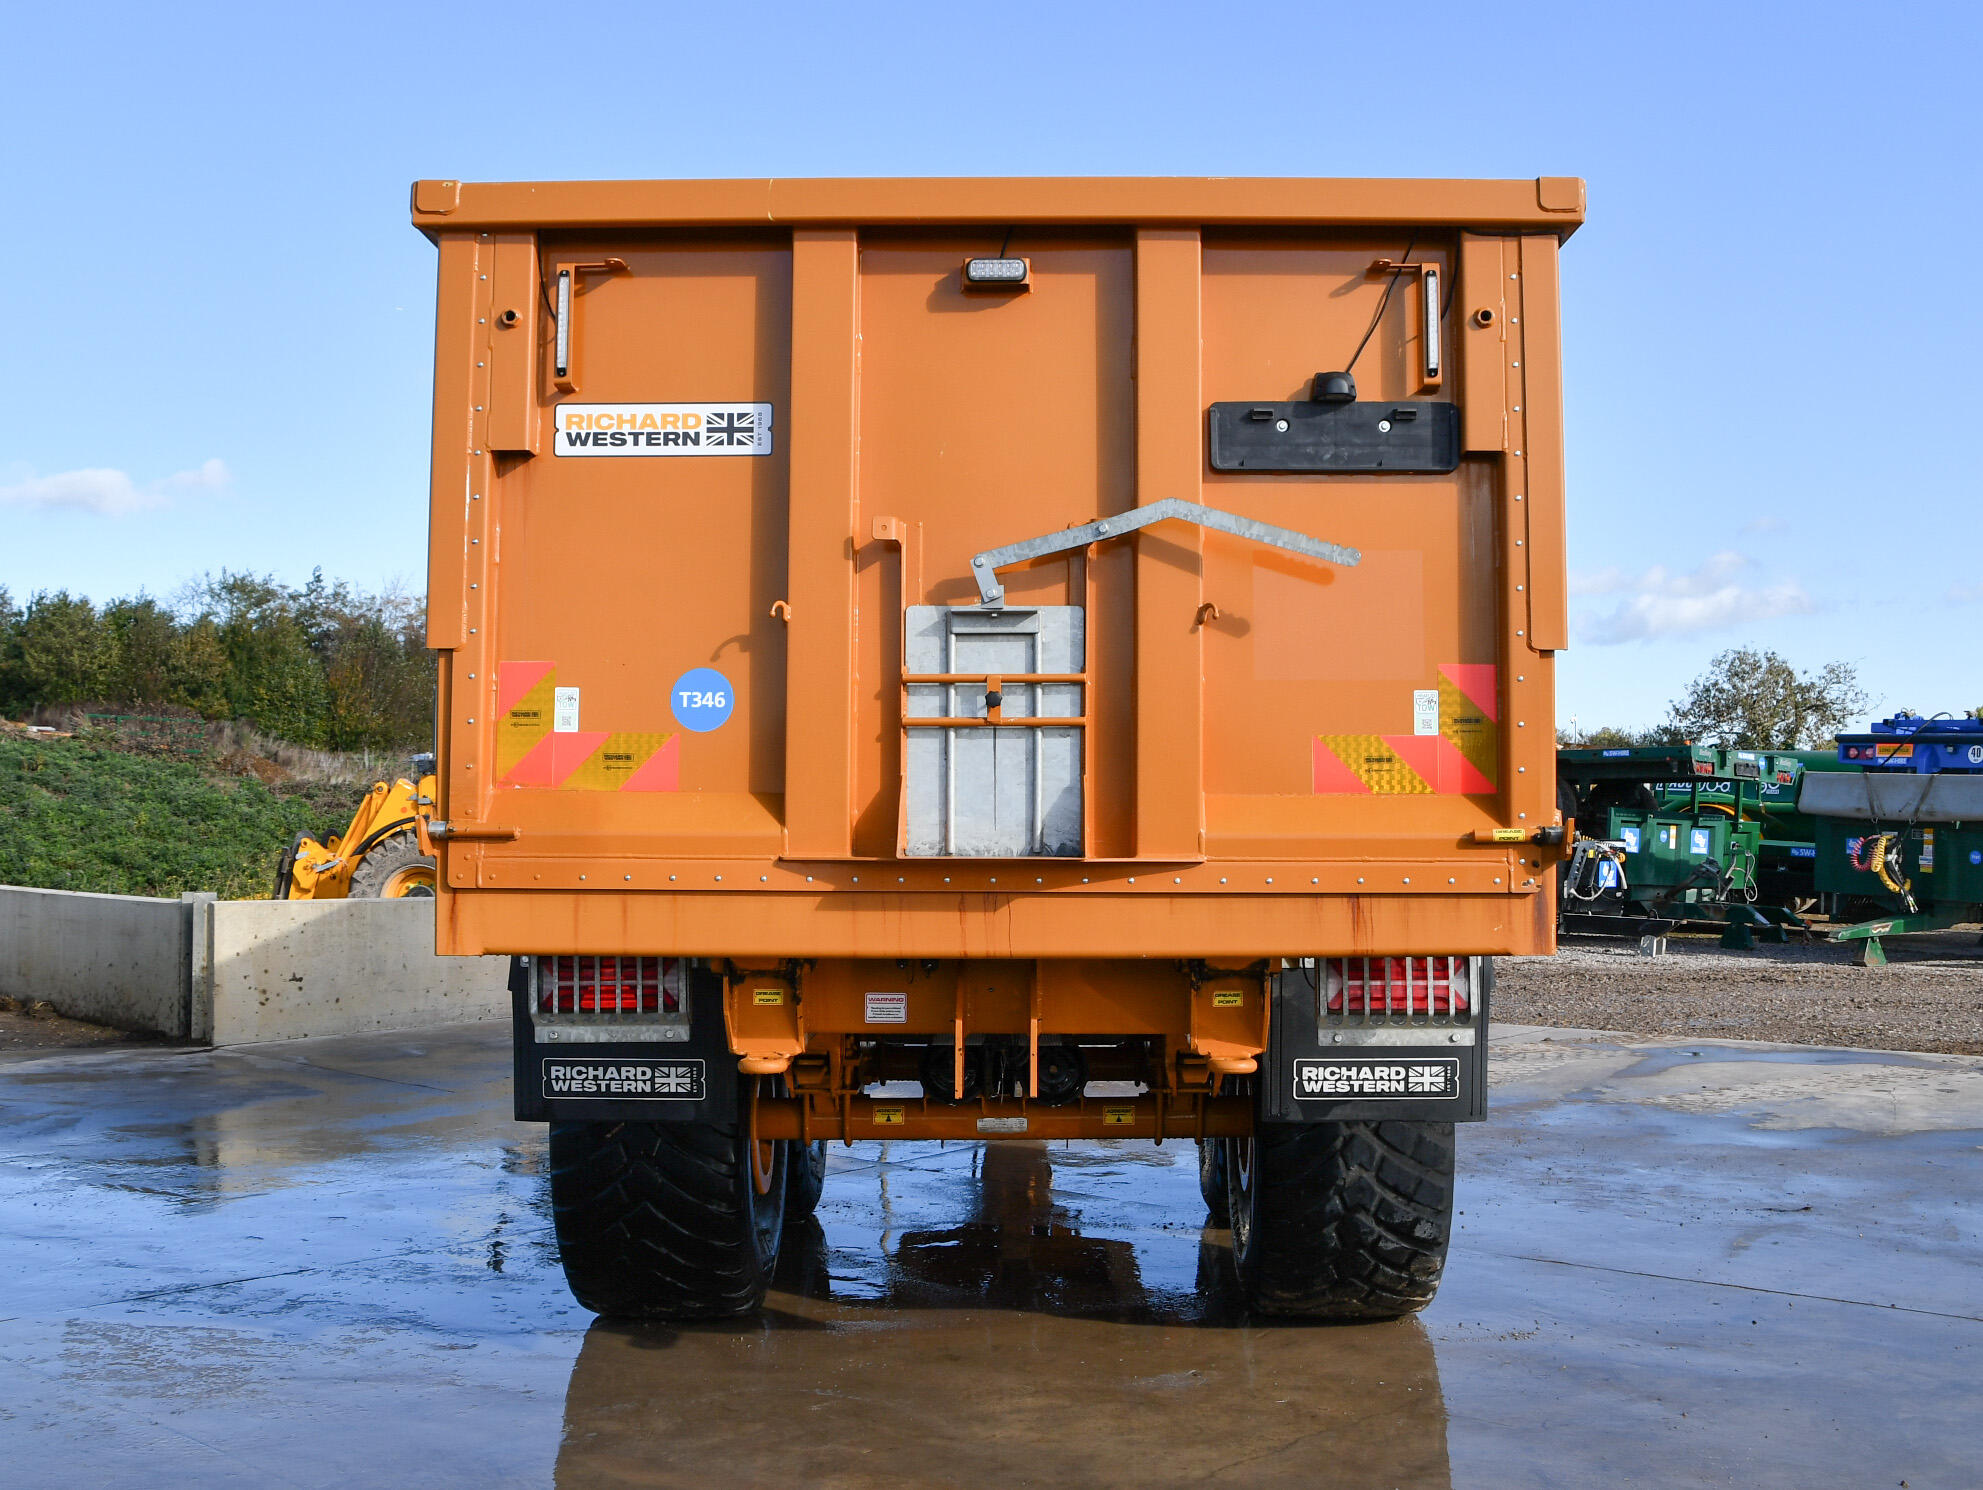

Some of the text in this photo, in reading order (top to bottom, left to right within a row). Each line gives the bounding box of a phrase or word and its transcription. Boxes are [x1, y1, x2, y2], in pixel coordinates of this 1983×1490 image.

[565, 413, 702, 431] RICHARD
[565, 431, 700, 447] WESTERN
[679, 691, 726, 708] T346
[1971, 747, 1982, 758] 40
[550, 1066, 653, 1080] RICHARD
[1301, 1066, 1407, 1080] RICHARD
[551, 1080, 651, 1093] WESTERN
[1302, 1080, 1405, 1093] WESTERN
